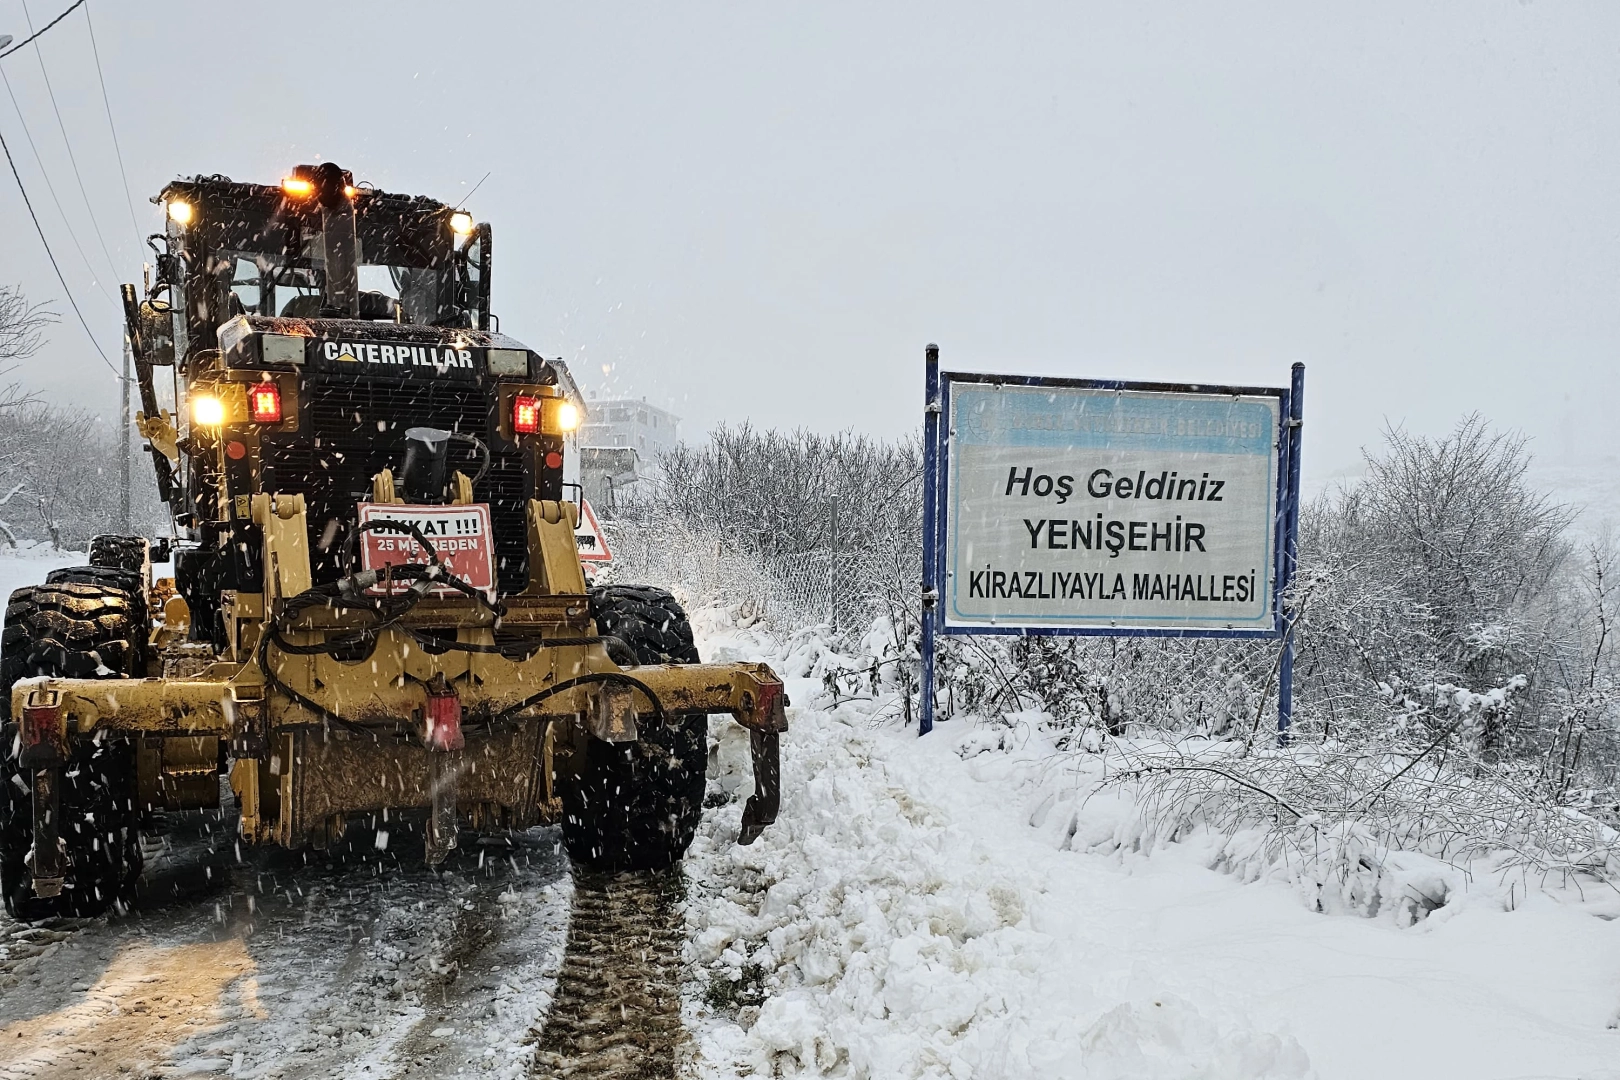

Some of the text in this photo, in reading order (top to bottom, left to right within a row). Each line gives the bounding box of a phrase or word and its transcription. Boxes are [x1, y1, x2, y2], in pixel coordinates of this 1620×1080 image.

[324, 341, 473, 369] CATERPILLAR
[1005, 467, 1226, 504] Hoş Geldiniz
[456, 518, 478, 534] !!!
[1023, 513, 1207, 558] YENİŞEHİR
[377, 539, 478, 551] 25 MEREDEN
[969, 564, 1256, 602] KİRAZLIYAYLA MAHALLESİ
